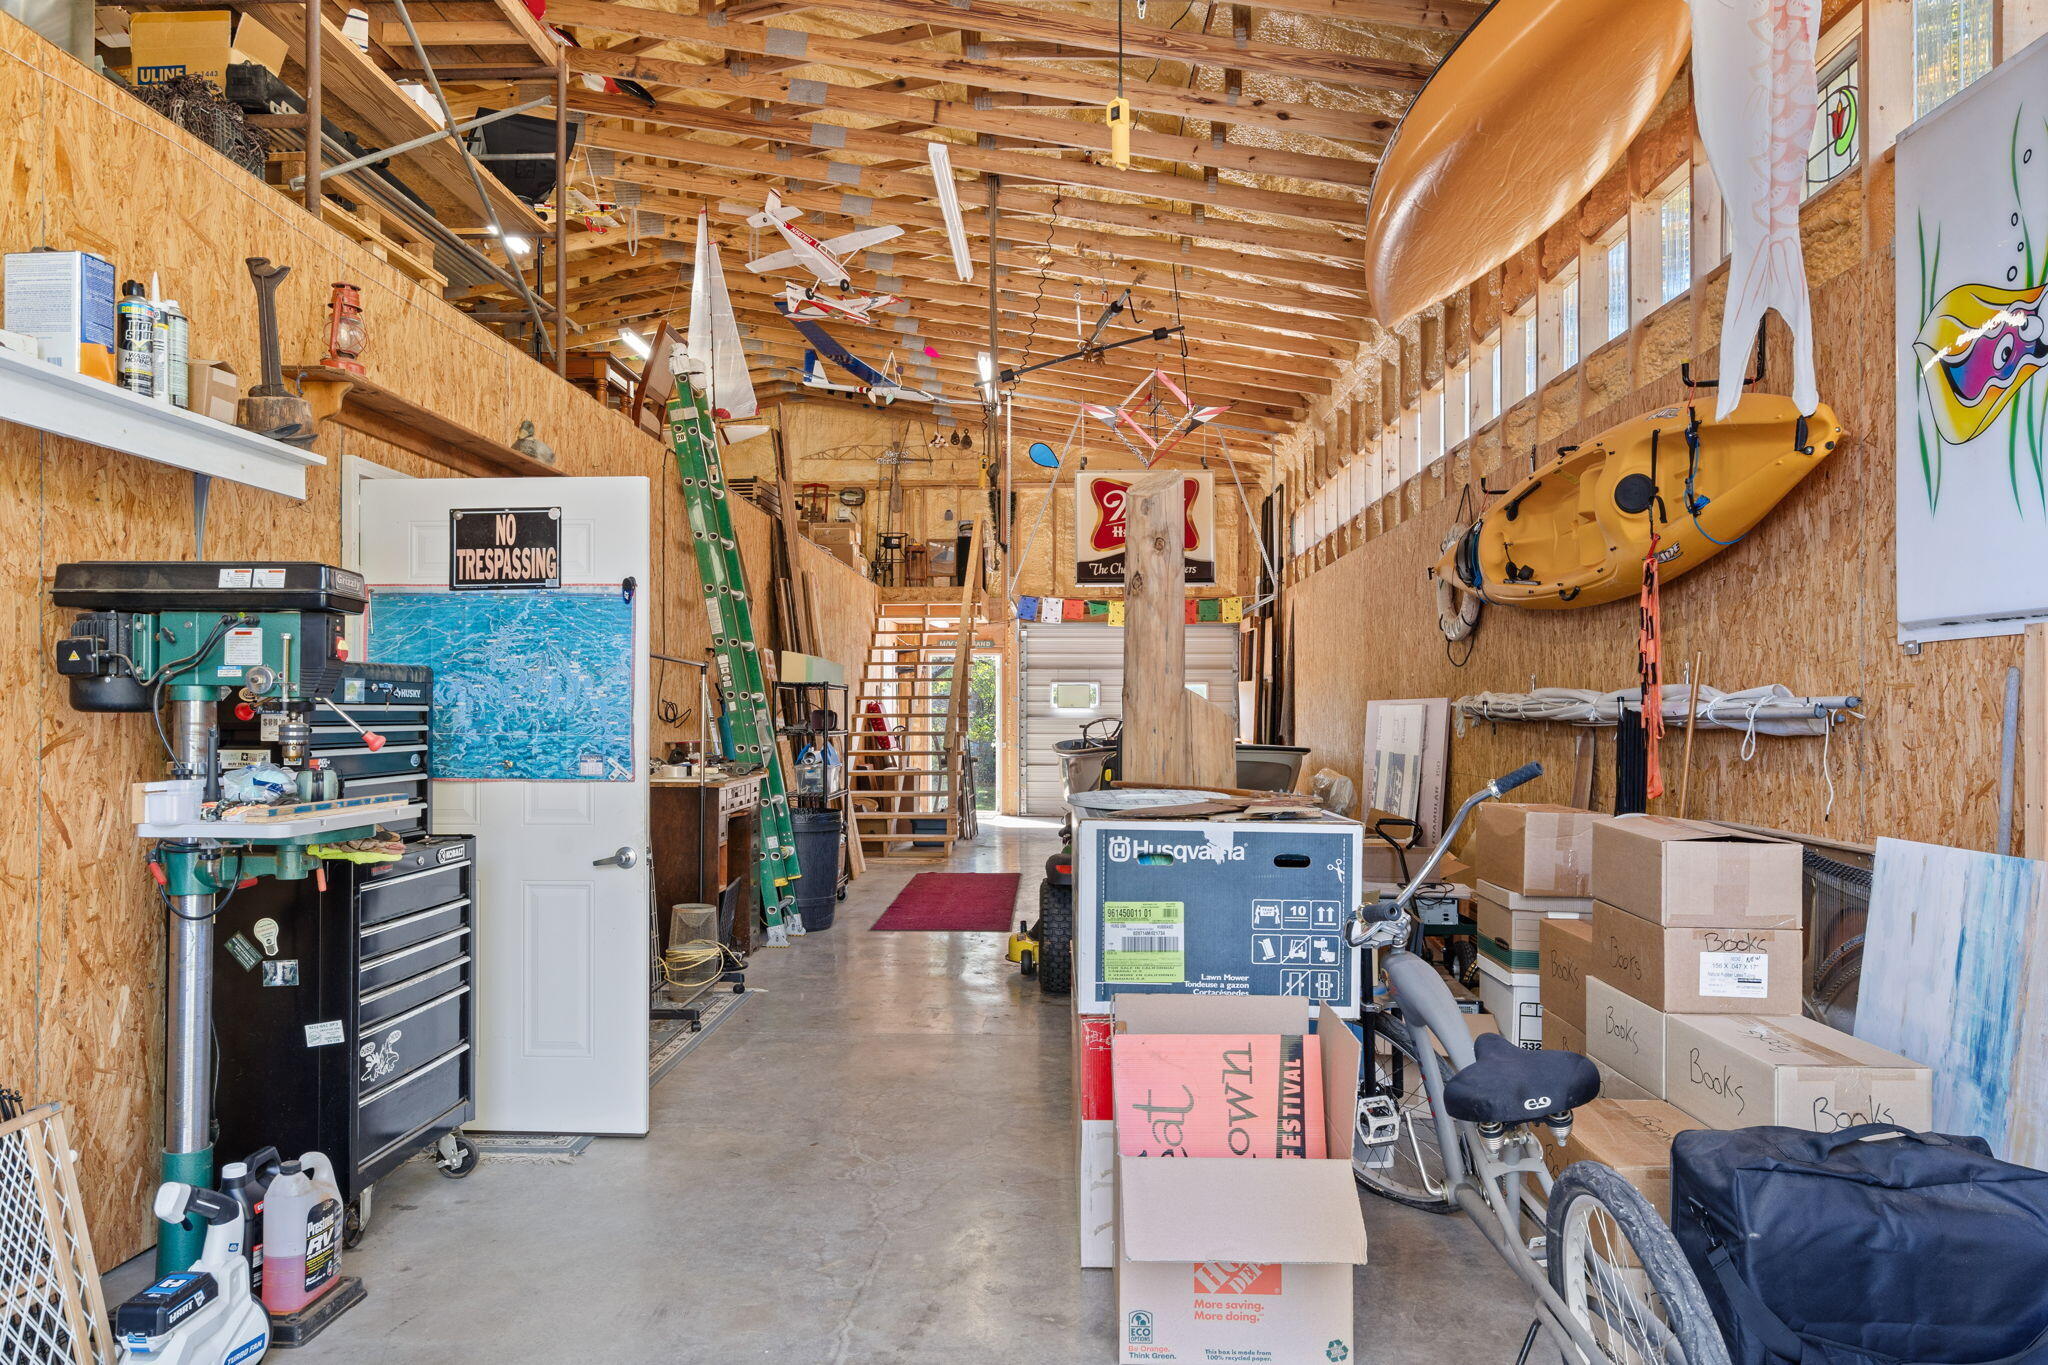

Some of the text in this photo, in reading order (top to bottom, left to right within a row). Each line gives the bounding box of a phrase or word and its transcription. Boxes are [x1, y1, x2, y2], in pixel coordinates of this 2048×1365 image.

[495, 513, 517, 546] NO
[456, 546, 557, 580] TRESPASSING
[401, 689, 421, 698] HUSKY
[1133, 840, 1245, 863] Husqvana
[1290, 906, 1307, 916] 10
[1704, 932, 1768, 953] Books
[1551, 949, 1580, 991] Books
[1610, 936, 1642, 980] Books
[1606, 1006, 1638, 1054] Books
[1690, 1048, 1745, 1116] Books
[1281, 1059, 1302, 1156] FESTIVAL
[1814, 1095, 1895, 1132] Books
[306, 1226, 333, 1256] RV
[168, 1300, 194, 1324] HART
[1194, 1300, 1265, 1312] More saving.
[1194, 1311, 1260, 1324] More doing.
[1130, 1328, 1150, 1336] ECO
[228, 1340, 262, 1365] TURBO FAN
